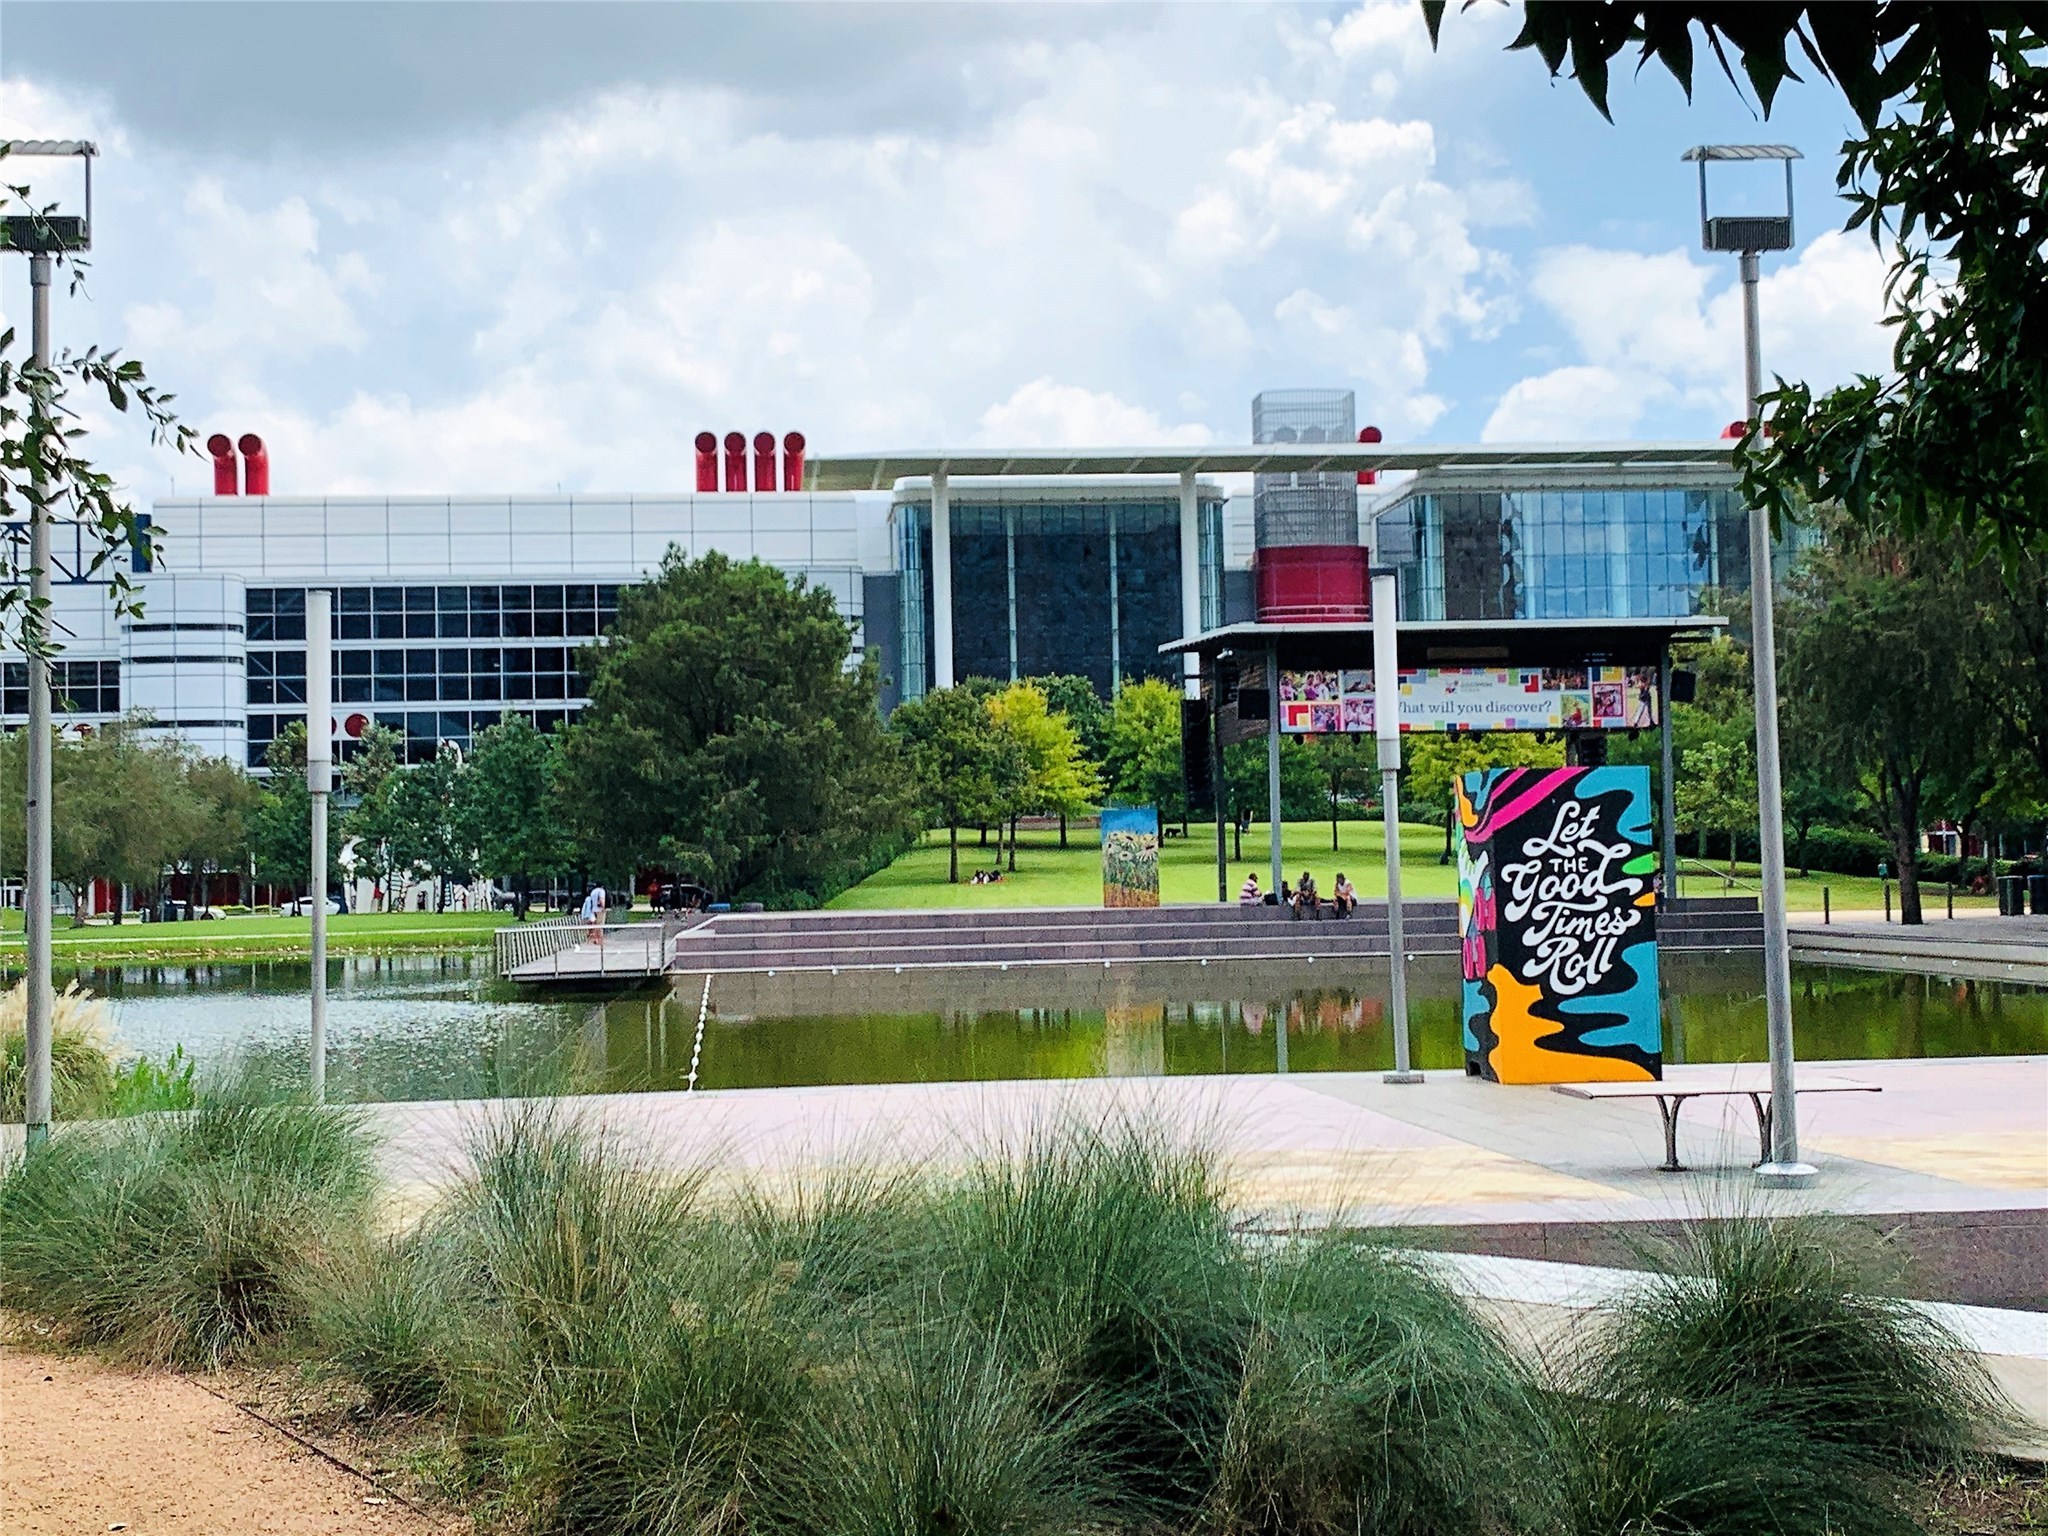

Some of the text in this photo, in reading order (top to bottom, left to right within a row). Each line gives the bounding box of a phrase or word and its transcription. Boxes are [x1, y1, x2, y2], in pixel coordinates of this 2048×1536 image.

[1398, 700, 1552, 716] hat will you discover?
[1522, 800, 1601, 858] Let
[1501, 839, 1644, 922] Good
[1549, 858, 1589, 874] THE
[1522, 895, 1642, 947] Times
[1522, 936, 1618, 996] Roll
